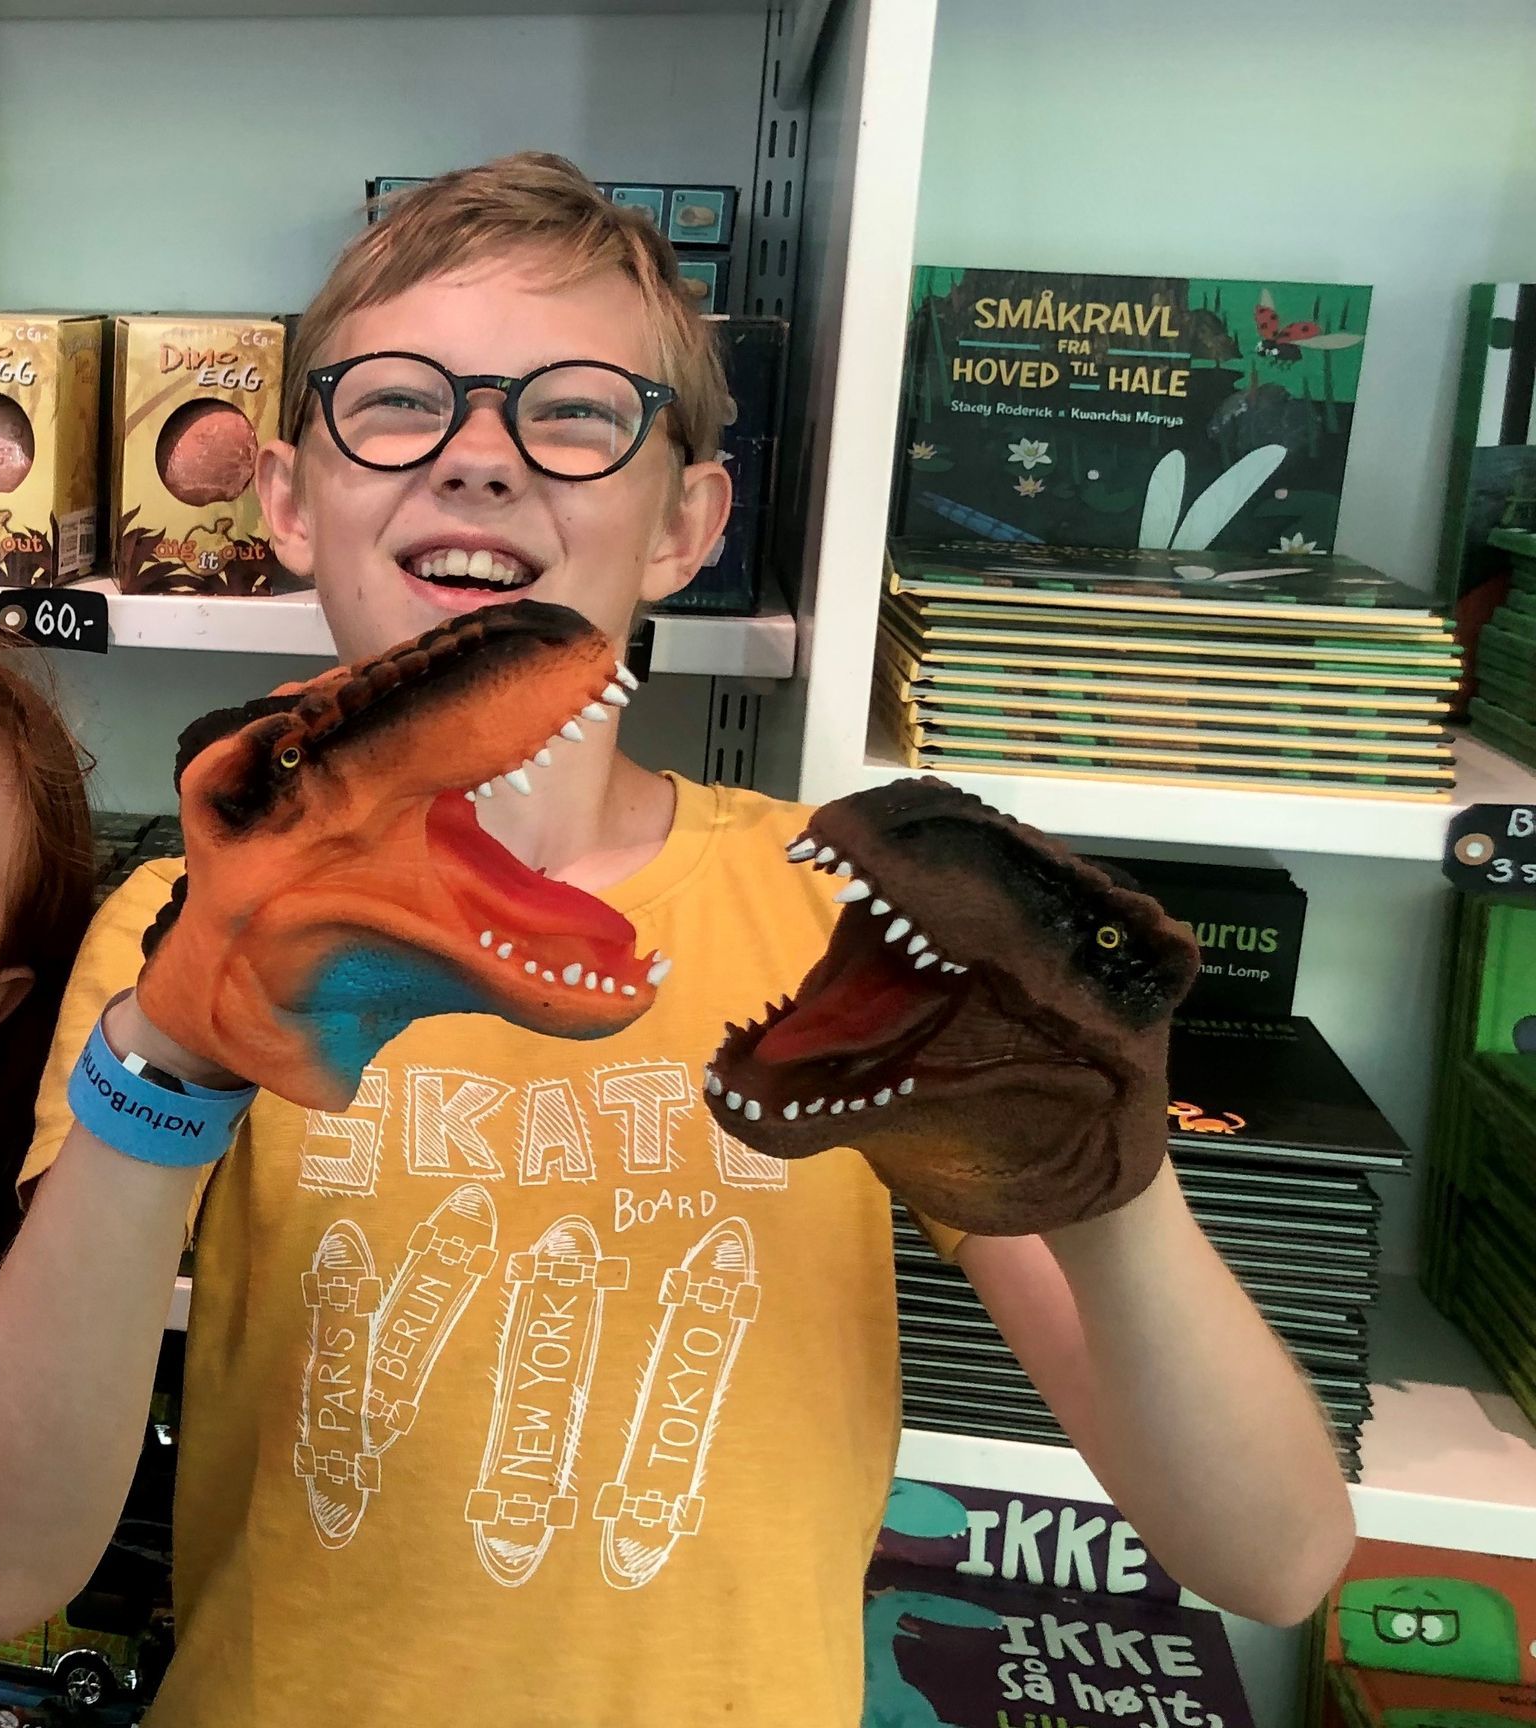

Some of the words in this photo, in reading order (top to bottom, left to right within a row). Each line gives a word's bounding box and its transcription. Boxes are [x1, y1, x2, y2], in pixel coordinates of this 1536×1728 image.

[974, 289, 1180, 338] SMÅKRAVL
[159, 344, 238, 373] Dino
[1058, 339, 1091, 355] FRA
[198, 367, 264, 391] EGG
[952, 357, 1060, 389] HOVED
[1070, 361, 1099, 377] TIL
[1108, 366, 1191, 398] HALE
[950, 399, 992, 417] Stacey
[996, 402, 1052, 418] Roderick
[1071, 407, 1131, 423] Kwanchai
[1135, 411, 1185, 428] Moriya
[1, 533, 44, 553] out
[154, 537, 197, 561] dig
[198, 549, 219, 570] it
[222, 542, 266, 561] out
[1195, 921, 1280, 953] urus
[1228, 963, 1271, 982] Lomp
[613, 1188, 717, 1232] BOARD
[377, 1275, 452, 1382] BERLIN
[518, 1294, 579, 1390] YORK
[318, 1327, 357, 1434] PARIS
[647, 1326, 725, 1469] TOKYO
[501, 1403, 557, 1482] NEW
[955, 1499, 1148, 1595] IKKE
[998, 1612, 1203, 1678] IKKE
[996, 1658, 1056, 1706] Så
[1067, 1672, 1224, 1728] højt,
[996, 1709, 1091, 1728] Lill
